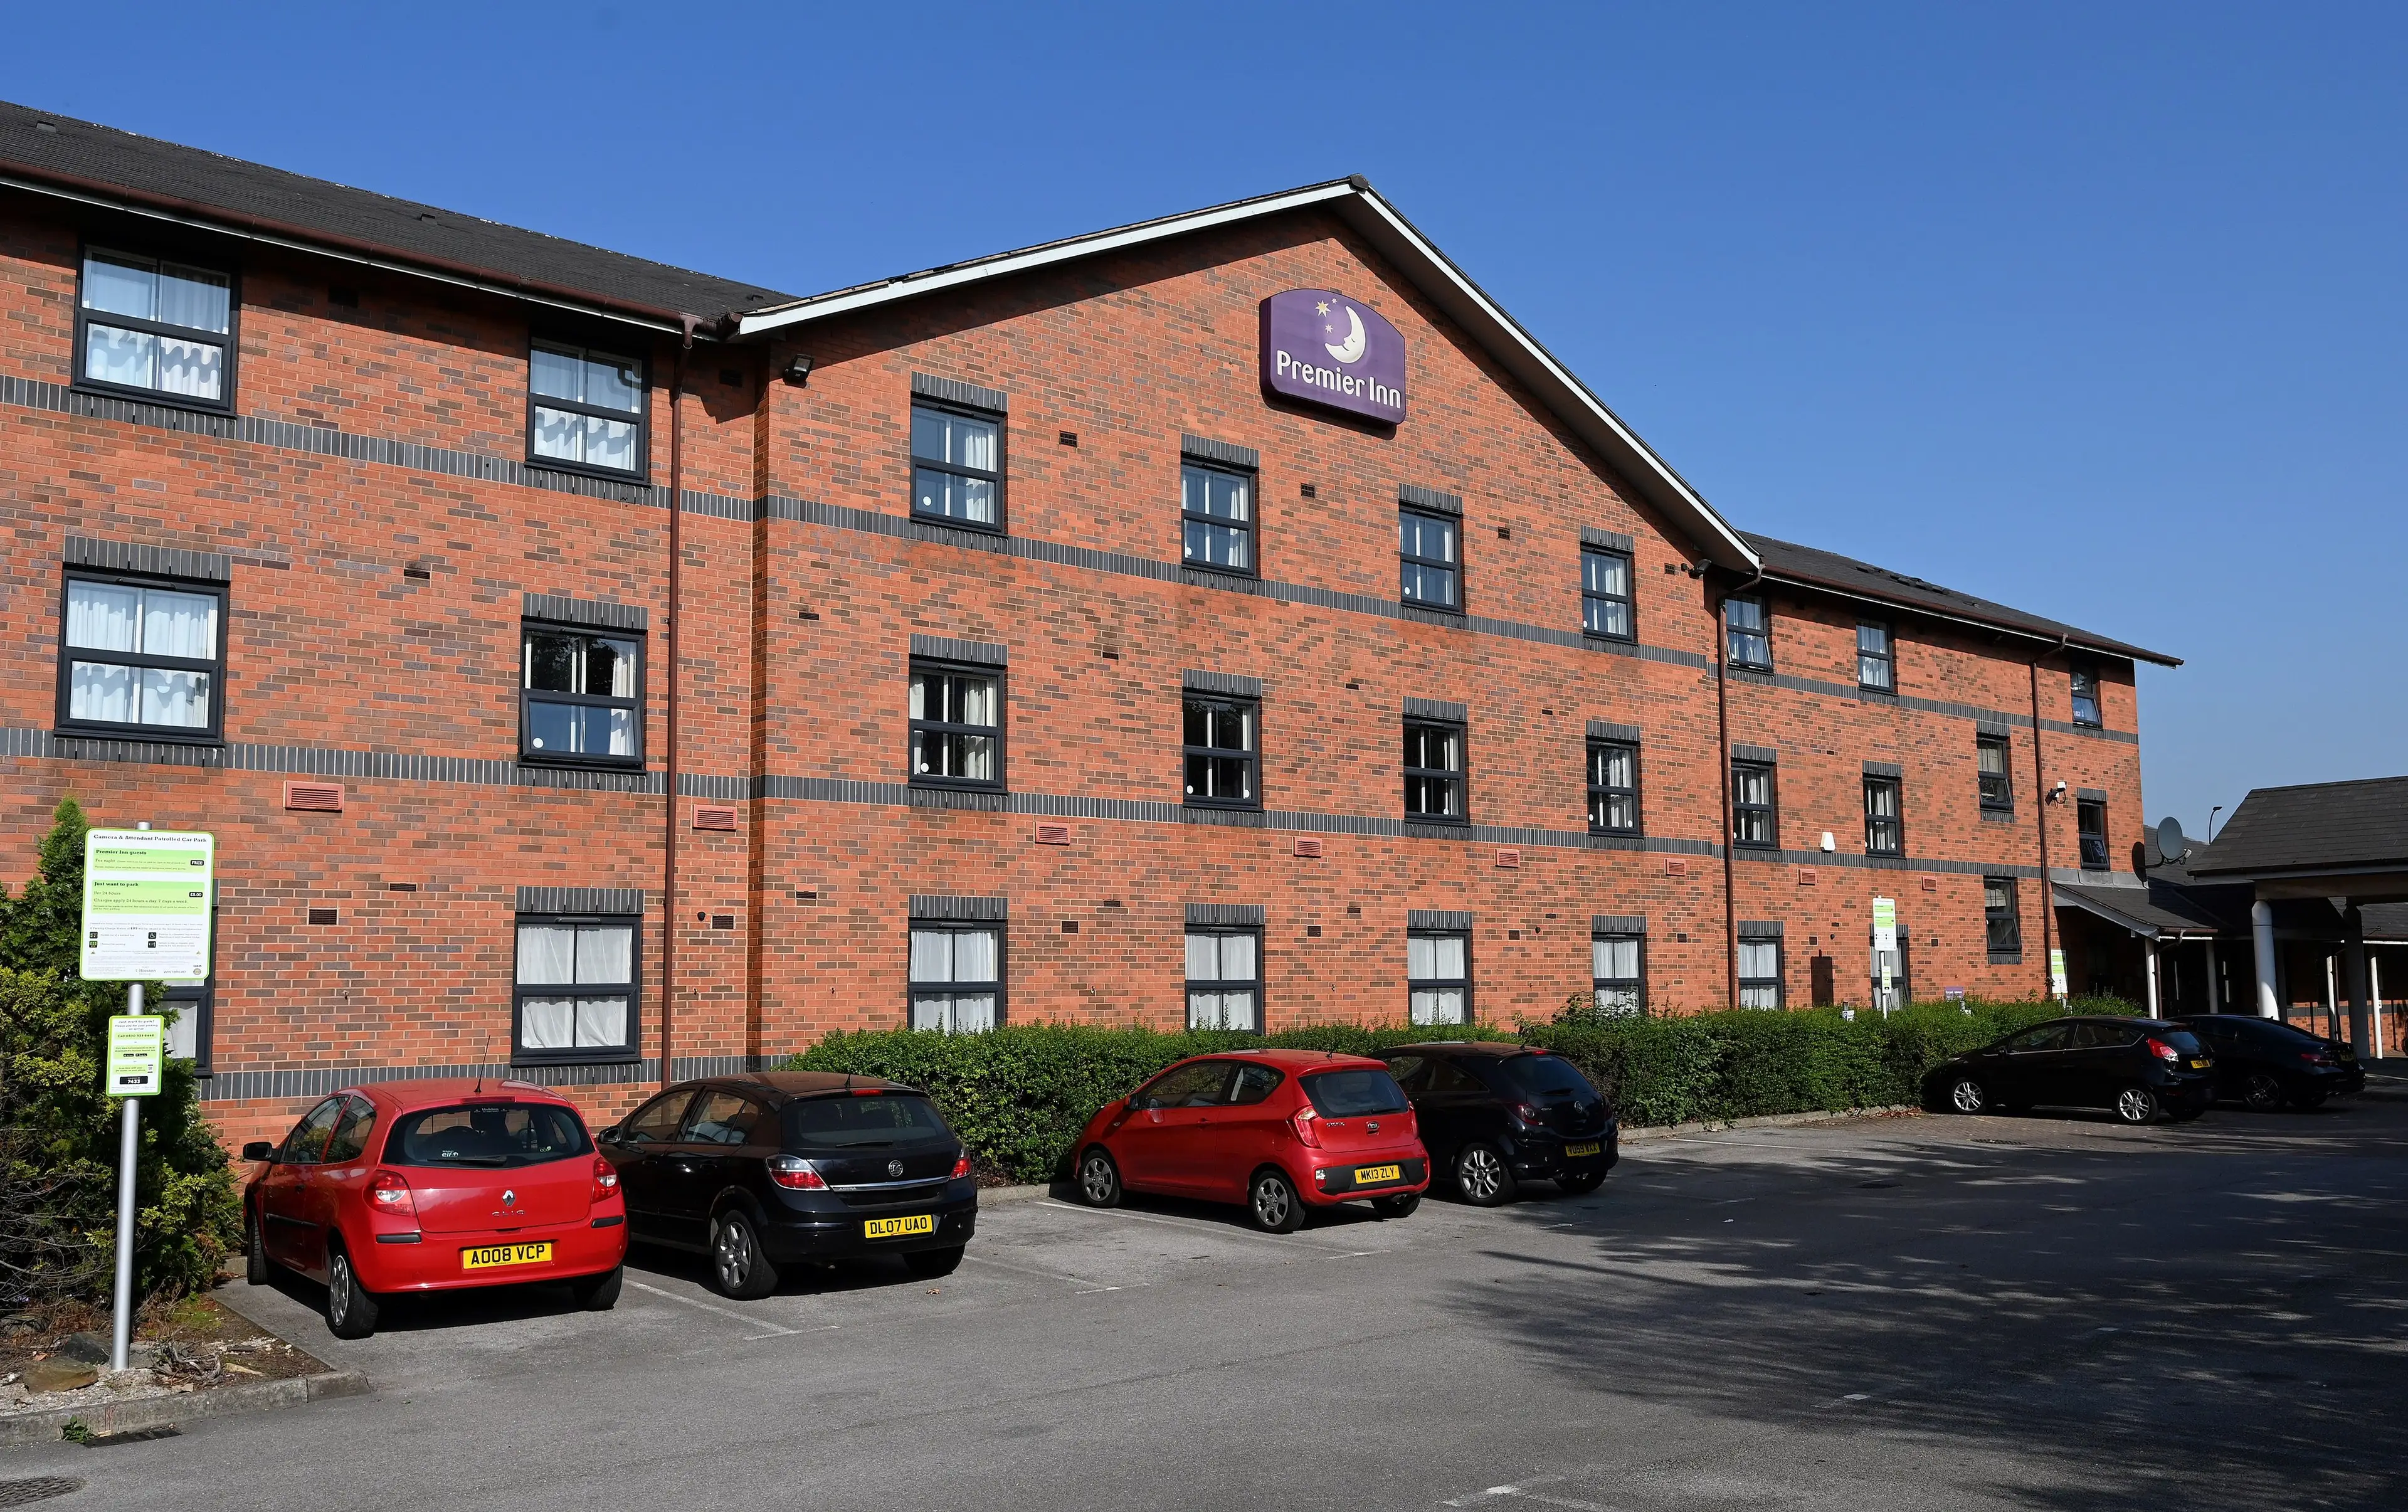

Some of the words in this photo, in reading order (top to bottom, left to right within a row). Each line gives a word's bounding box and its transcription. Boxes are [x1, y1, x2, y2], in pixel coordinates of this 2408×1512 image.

[1277, 349, 1366, 397] Premier
[1370, 376, 1402, 408] Inn
[1360, 1169, 1379, 1180] MK13
[1380, 1167, 1394, 1178] ZLY
[870, 1220, 902, 1234] DL07
[905, 1217, 927, 1230] UAO
[471, 1247, 511, 1265] AO08
[516, 1244, 545, 1261] VCP
